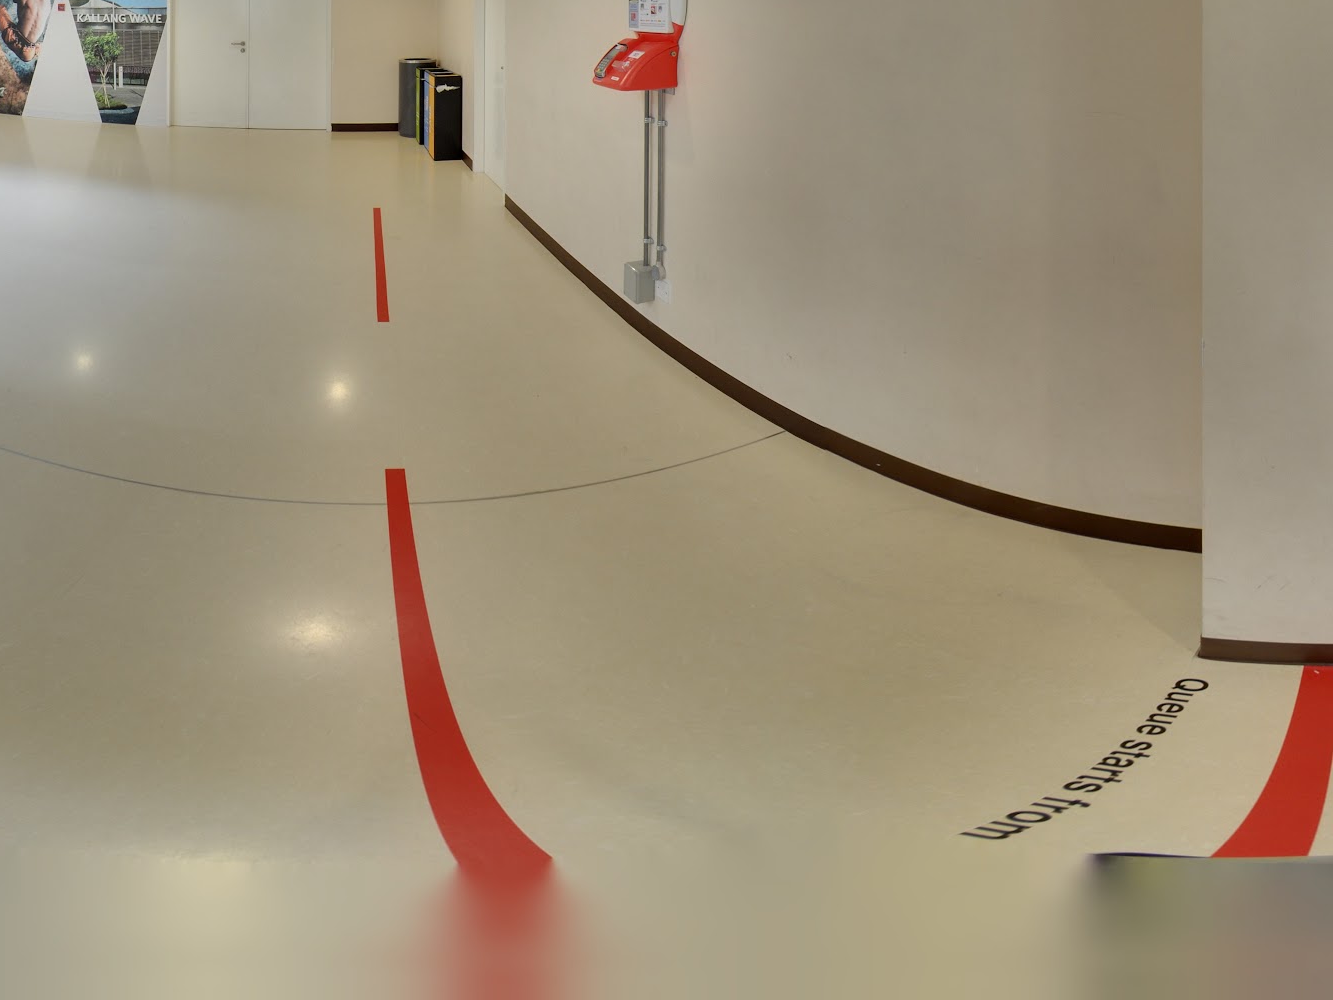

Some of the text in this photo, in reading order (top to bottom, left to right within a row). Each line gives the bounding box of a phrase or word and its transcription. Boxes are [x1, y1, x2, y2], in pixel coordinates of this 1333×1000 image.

[76, 13, 163, 24] KALLANG WAVE
[959, 678, 1209, 840] Queue starts from
